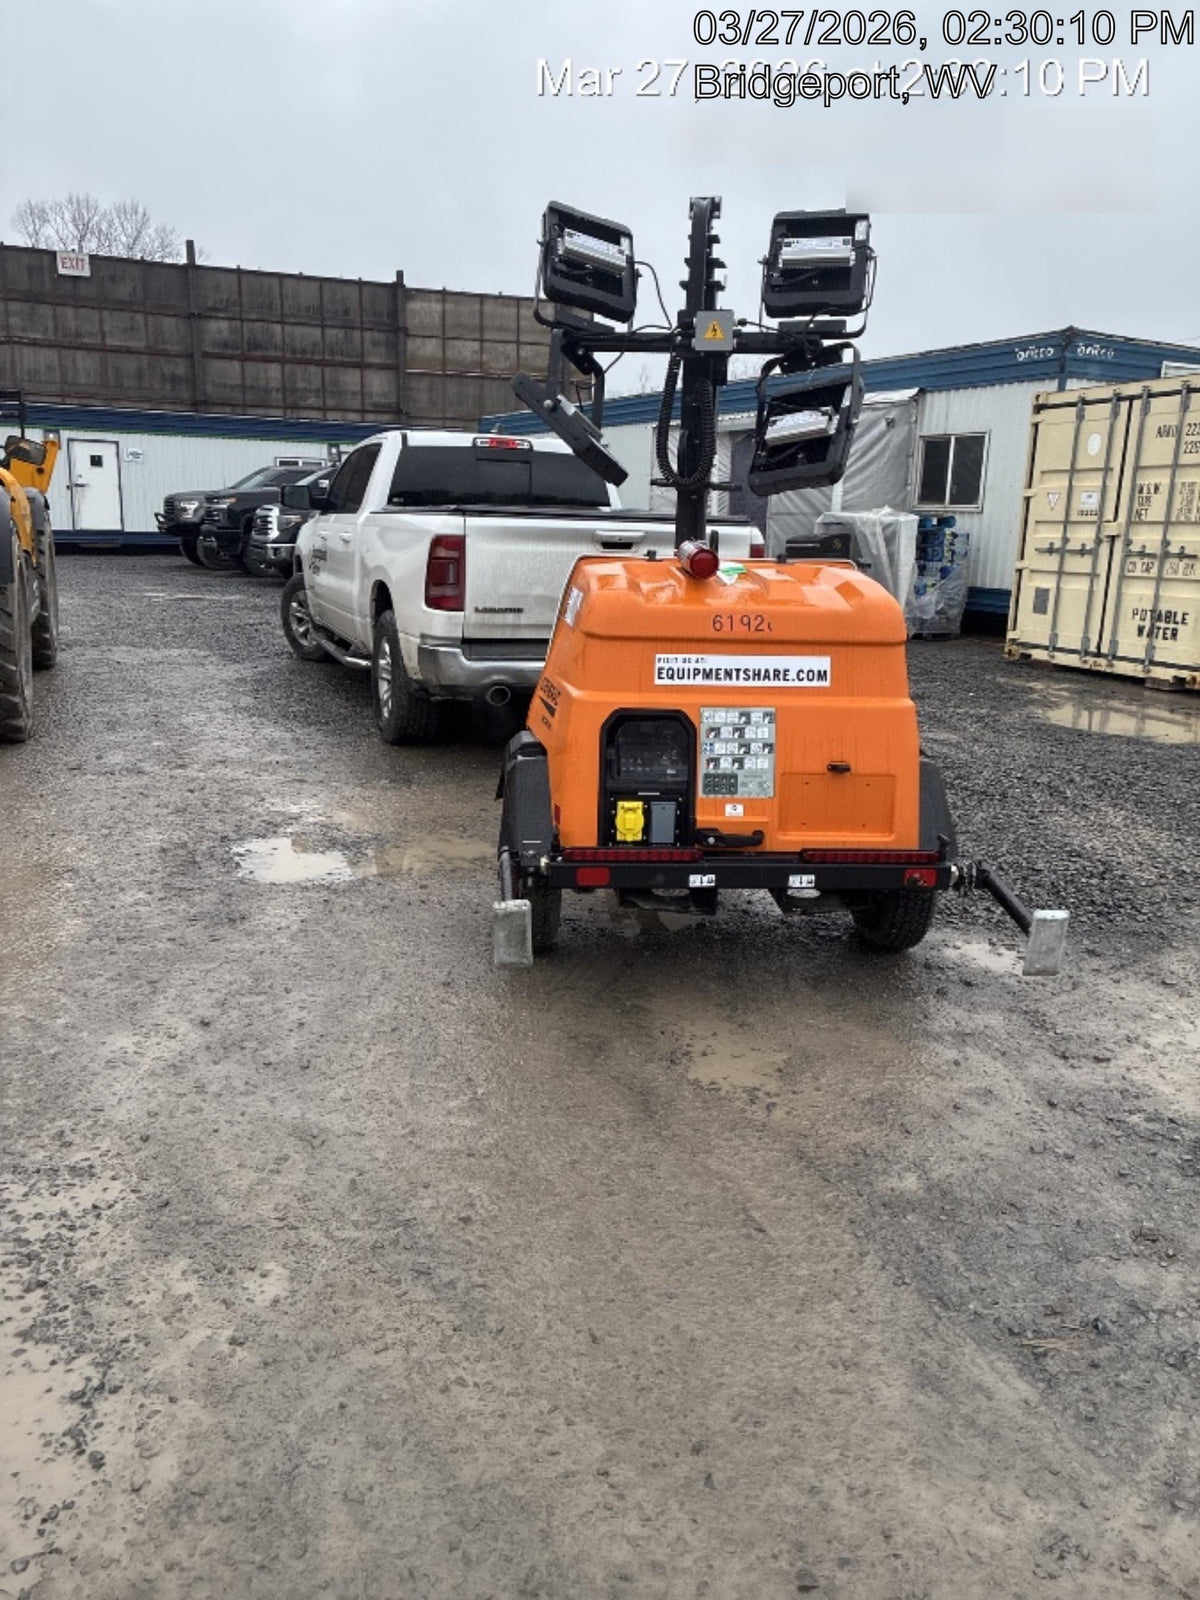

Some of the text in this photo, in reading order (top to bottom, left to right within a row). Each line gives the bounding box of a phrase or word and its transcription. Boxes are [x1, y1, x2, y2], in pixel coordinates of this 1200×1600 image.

[60, 255, 86, 271] EXIT
[1132, 607, 1190, 626] POTABLE
[1137, 624, 1179, 641] WATER
[656, 667, 828, 682] EQUIPMENTSHARE.COM
